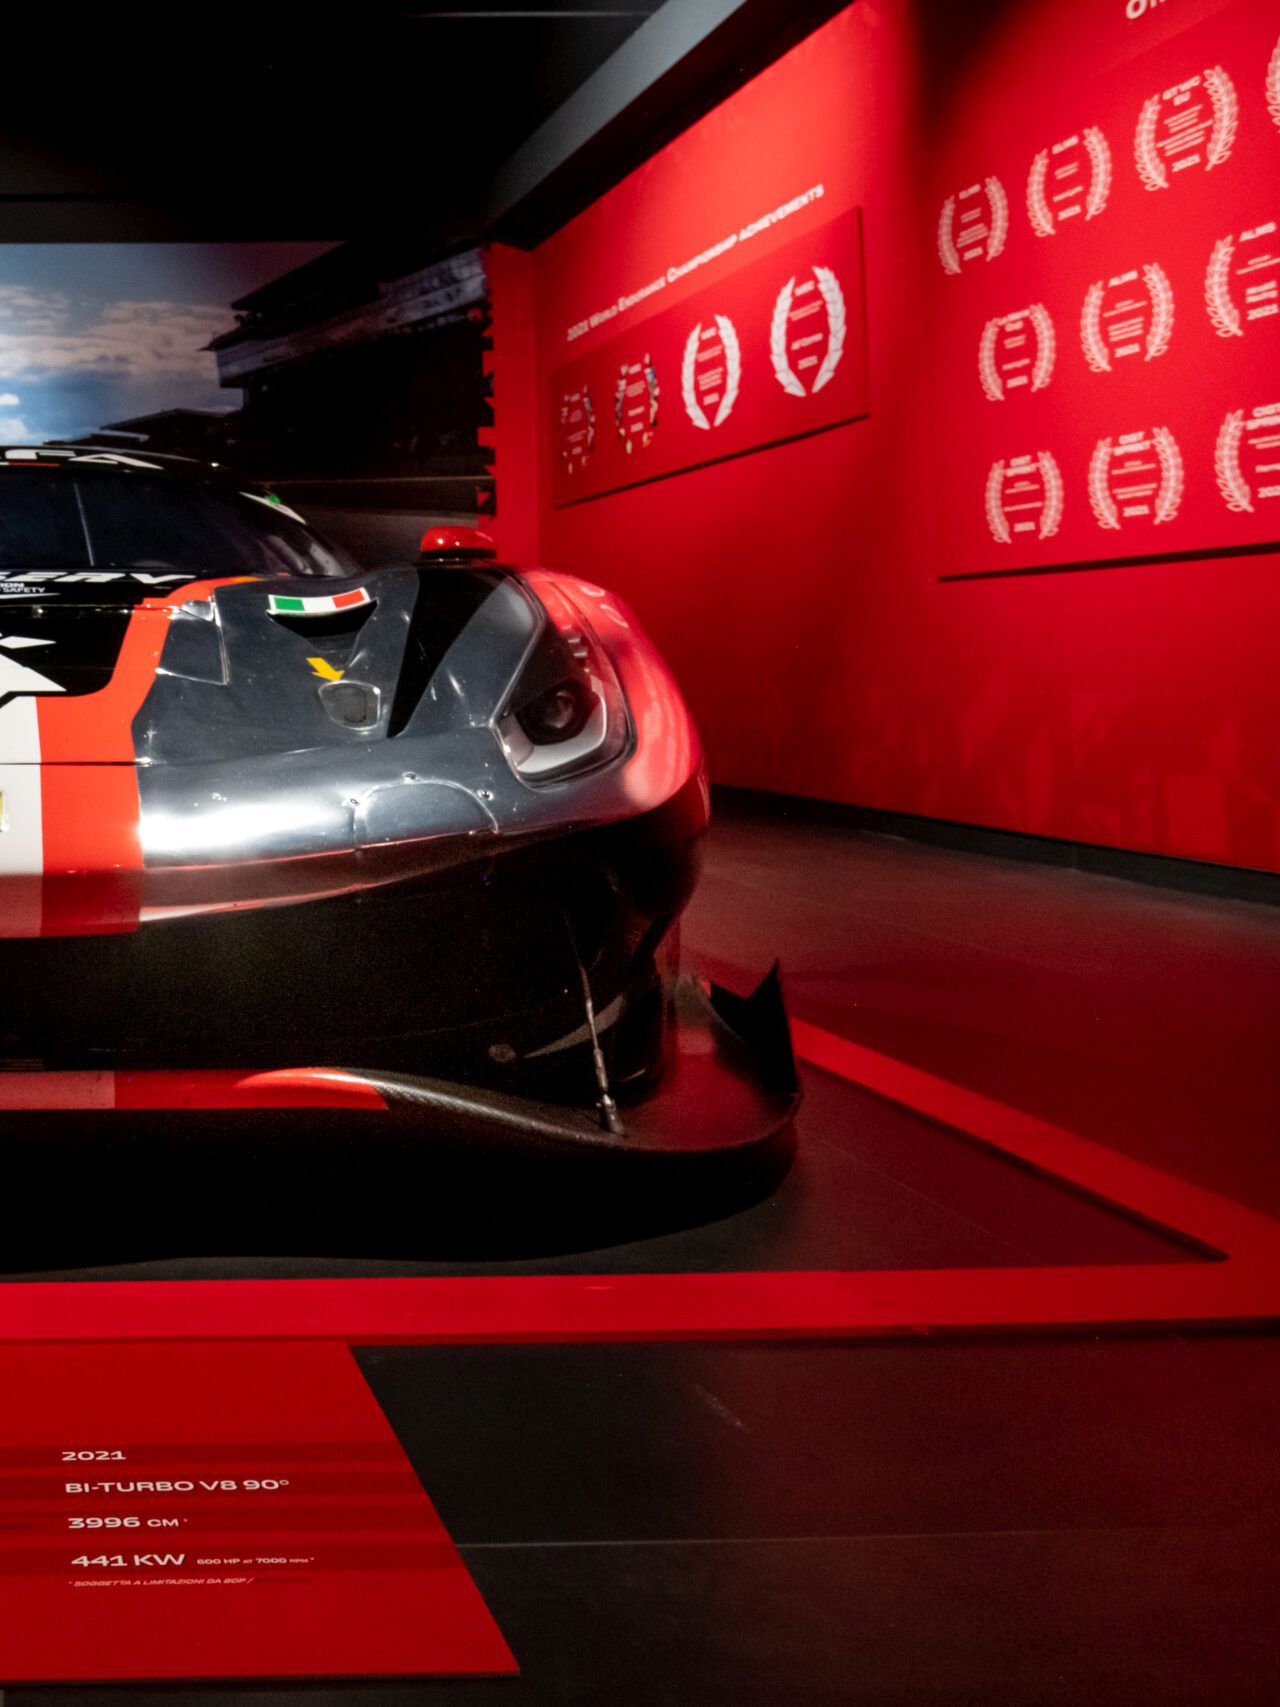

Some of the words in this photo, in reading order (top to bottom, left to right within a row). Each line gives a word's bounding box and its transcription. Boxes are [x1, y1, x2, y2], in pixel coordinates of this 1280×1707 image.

[62, 1451, 126, 1461] 2021
[65, 1481, 195, 1493] BI-TURBO
[199, 1480, 237, 1491] V8
[68, 1517, 141, 1528] 3996
[147, 1518, 188, 1527] CM
[71, 1555, 128, 1567] 441
[133, 1554, 185, 1566] KW
